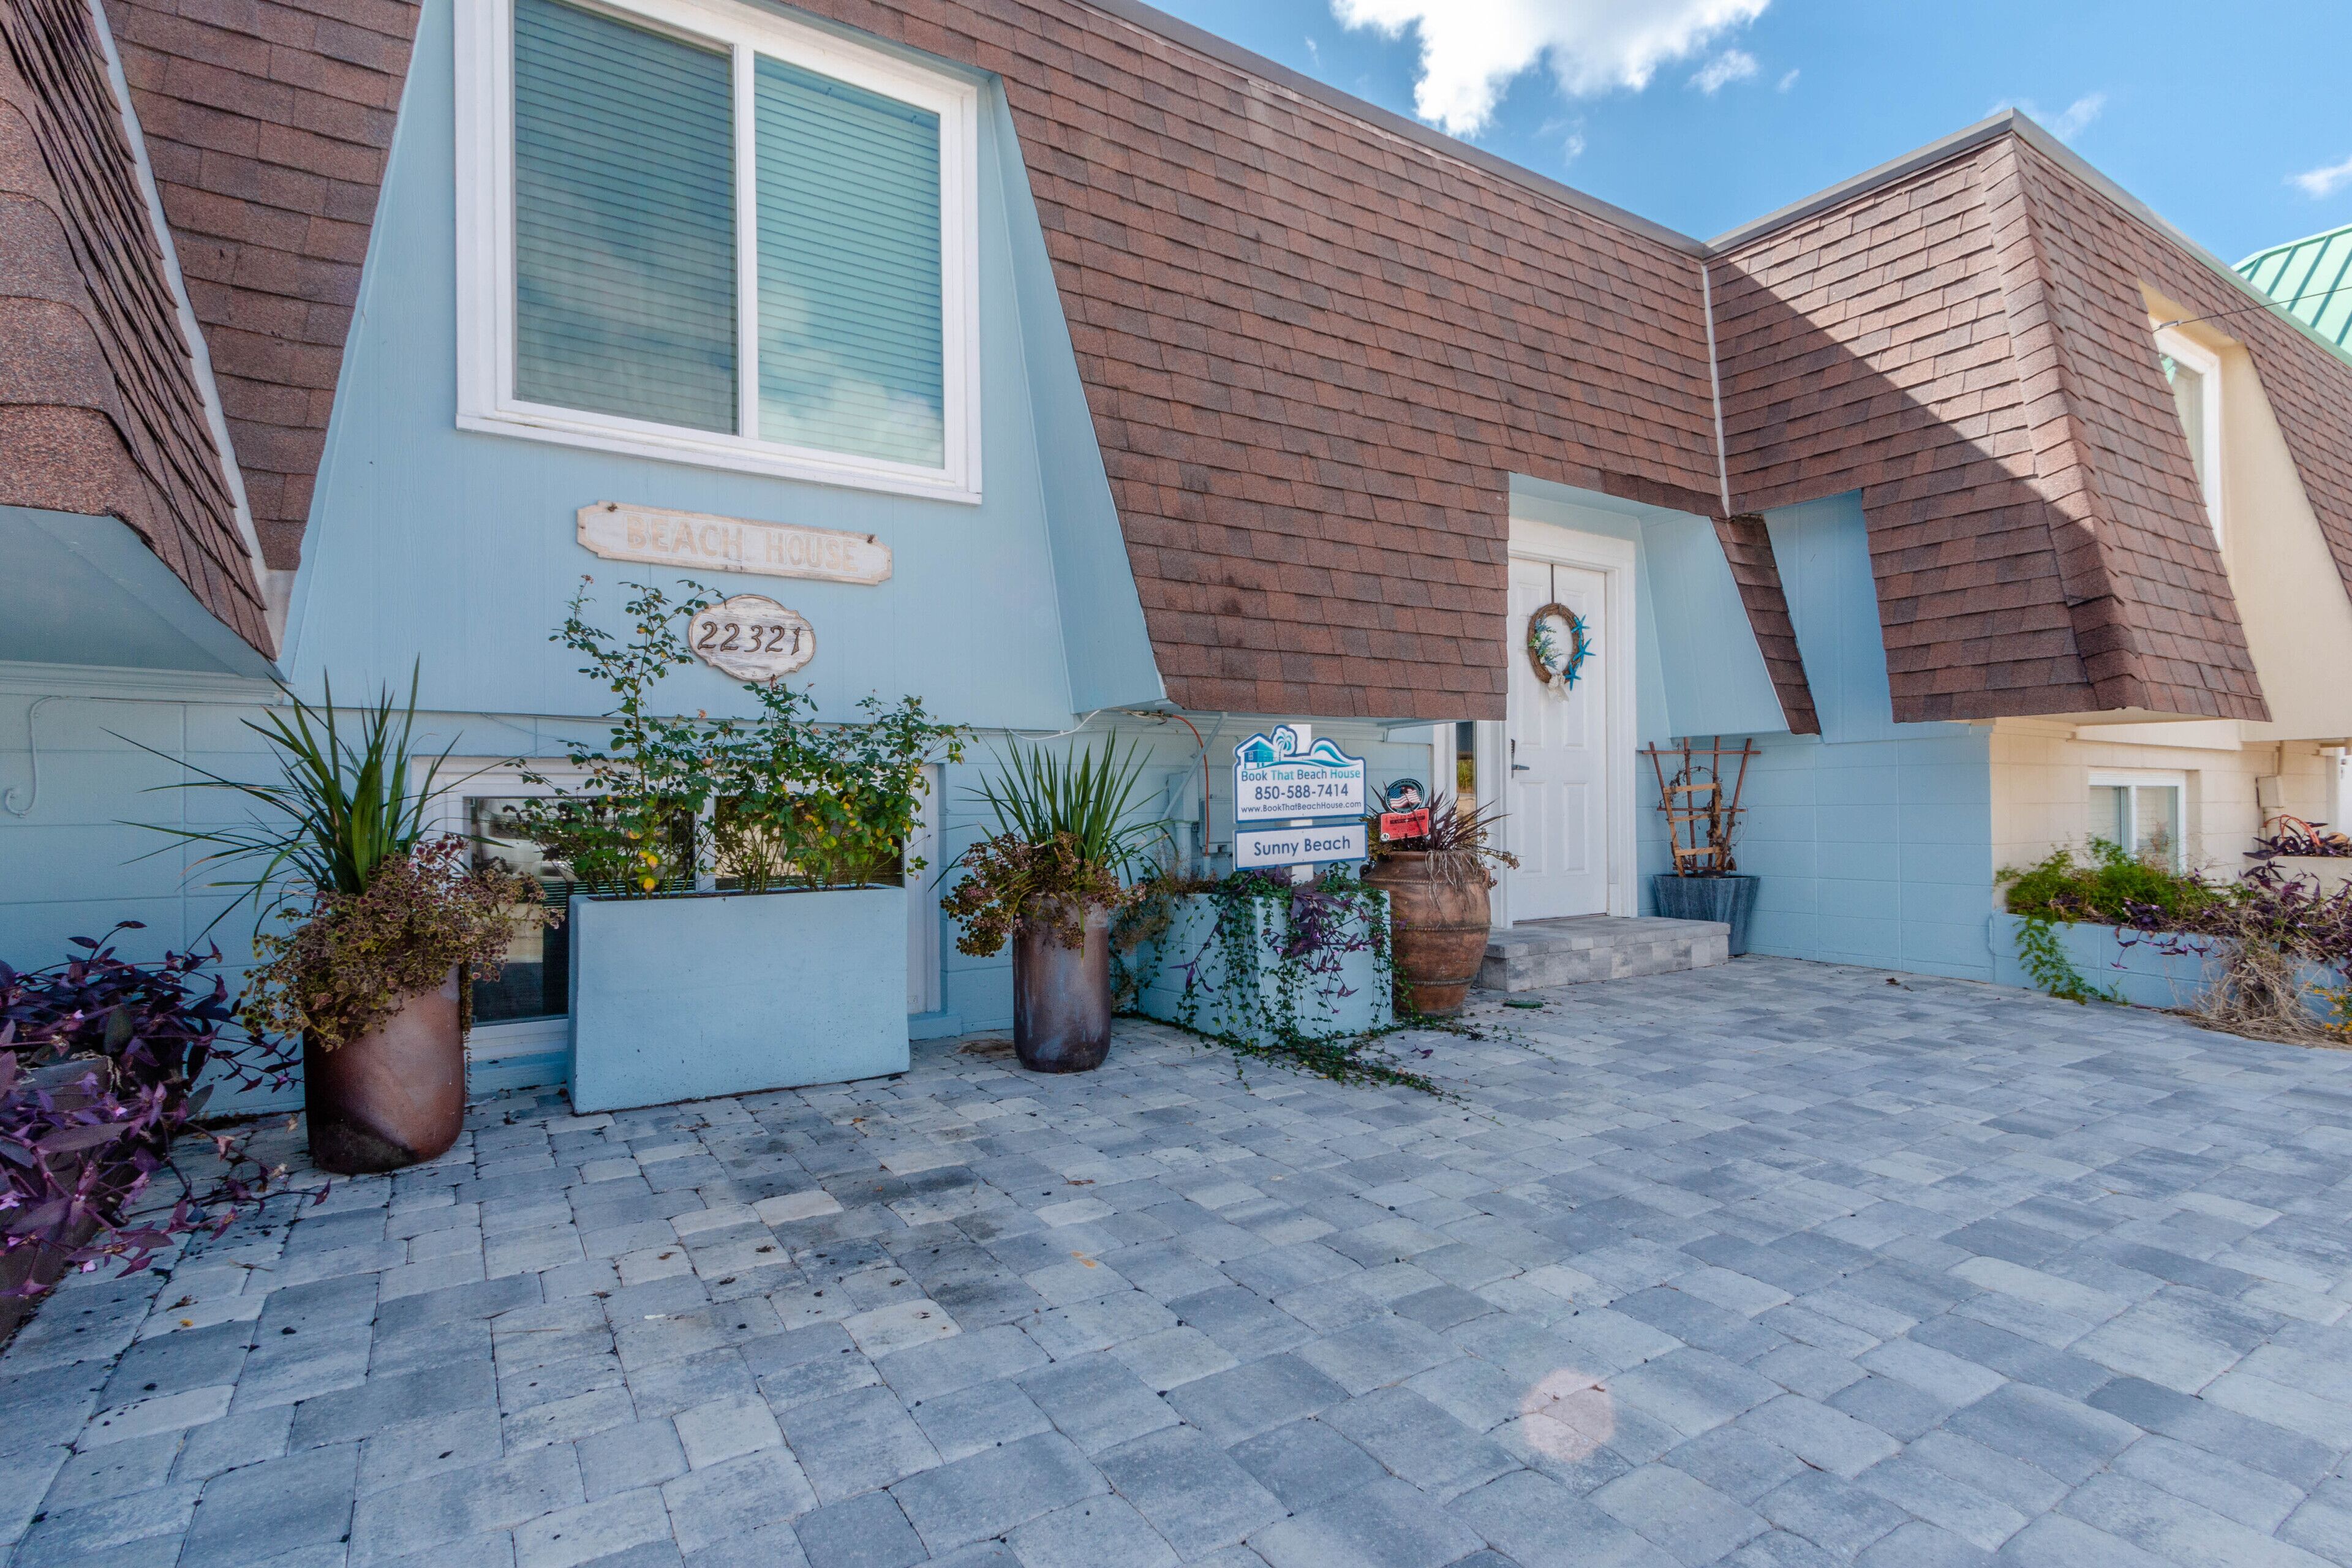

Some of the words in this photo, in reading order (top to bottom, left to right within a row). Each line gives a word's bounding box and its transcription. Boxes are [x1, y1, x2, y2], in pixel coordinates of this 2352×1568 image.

[627, 516, 742, 557] BEACH
[764, 530, 859, 572] HOUSE
[697, 621, 801, 656] 22321
[1241, 771, 1268, 782] Book
[1271, 770, 1294, 780] That
[1297, 769, 1327, 780] Beach
[1330, 768, 1361, 779] House
[1255, 783, 1348, 800] 850-588-7414
[1241, 801, 1361, 813] www.BookThatBeachHouse.com
[1254, 841, 1299, 856] Sunny
[1304, 835, 1351, 852] Beach
